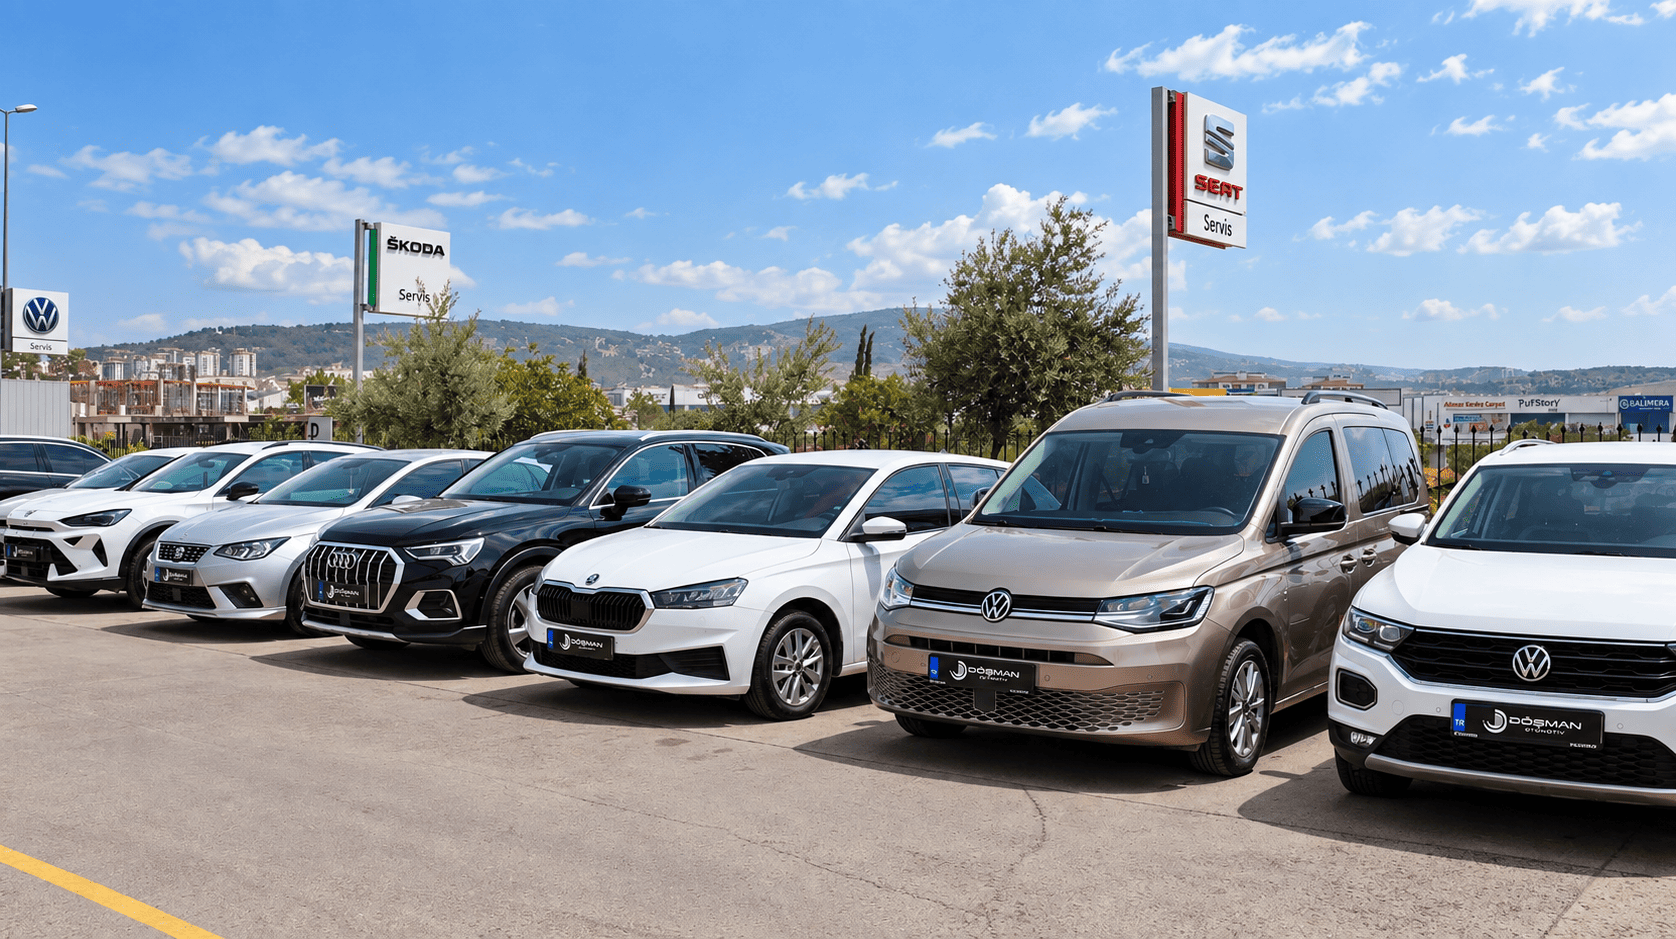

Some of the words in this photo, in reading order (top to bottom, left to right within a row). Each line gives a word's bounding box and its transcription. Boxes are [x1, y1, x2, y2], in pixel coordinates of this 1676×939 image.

[1195, 174, 1243, 200] SEAT
[1204, 213, 1233, 237] Servis
[387, 235, 445, 256] ŠKODA
[399, 288, 431, 303] Servis
[30, 342, 52, 351] Servis
[1454, 718, 1465, 727] TR
